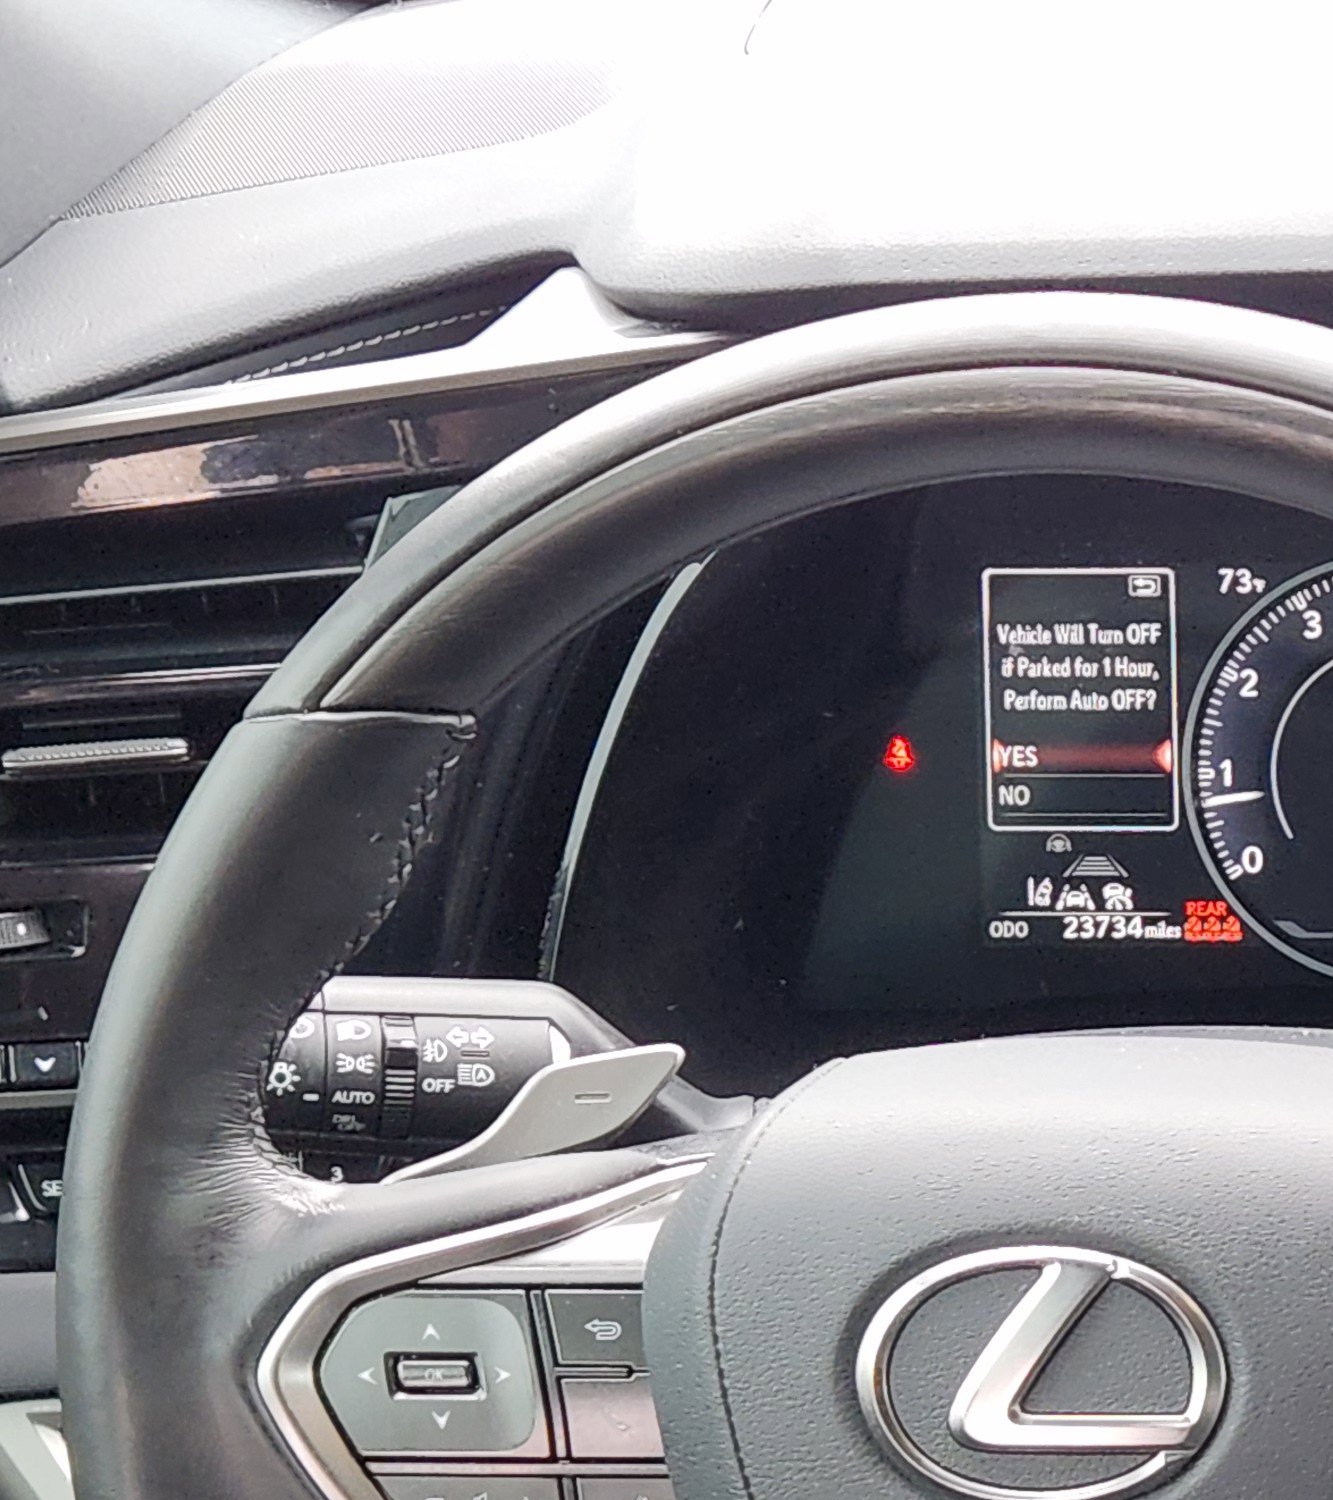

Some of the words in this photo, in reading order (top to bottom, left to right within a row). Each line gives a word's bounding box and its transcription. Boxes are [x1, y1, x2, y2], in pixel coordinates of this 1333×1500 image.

[996, 623, 1051, 645] Vehicle
[1053, 623, 1085, 645] Will
[1087, 623, 1124, 645] Turn
[1126, 623, 1162, 645] OFF
[1303, 611, 1323, 640] 3
[1016, 656, 1071, 678] Parked
[1073, 656, 1099, 678] for
[1102, 657, 1112, 677] 1
[1239, 669, 1259, 698] 2
[1003, 689, 1067, 711] Perform
[1070, 690, 1109, 711] Auto
[1111, 689, 1157, 711] OFF?
[1000, 745, 1039, 767] YES
[1220, 761, 1233, 787] 1
[998, 784, 1031, 806] NO
[1241, 846, 1263, 874] 0
[1185, 900, 1227, 917] REAR
[988, 920, 1029, 938] ODO
[1063, 916, 1143, 939] 23734
[422, 1077, 455, 1094] OFF
[331, 1090, 375, 1105] AUTO
[41, 1180, 64, 1198] SE
